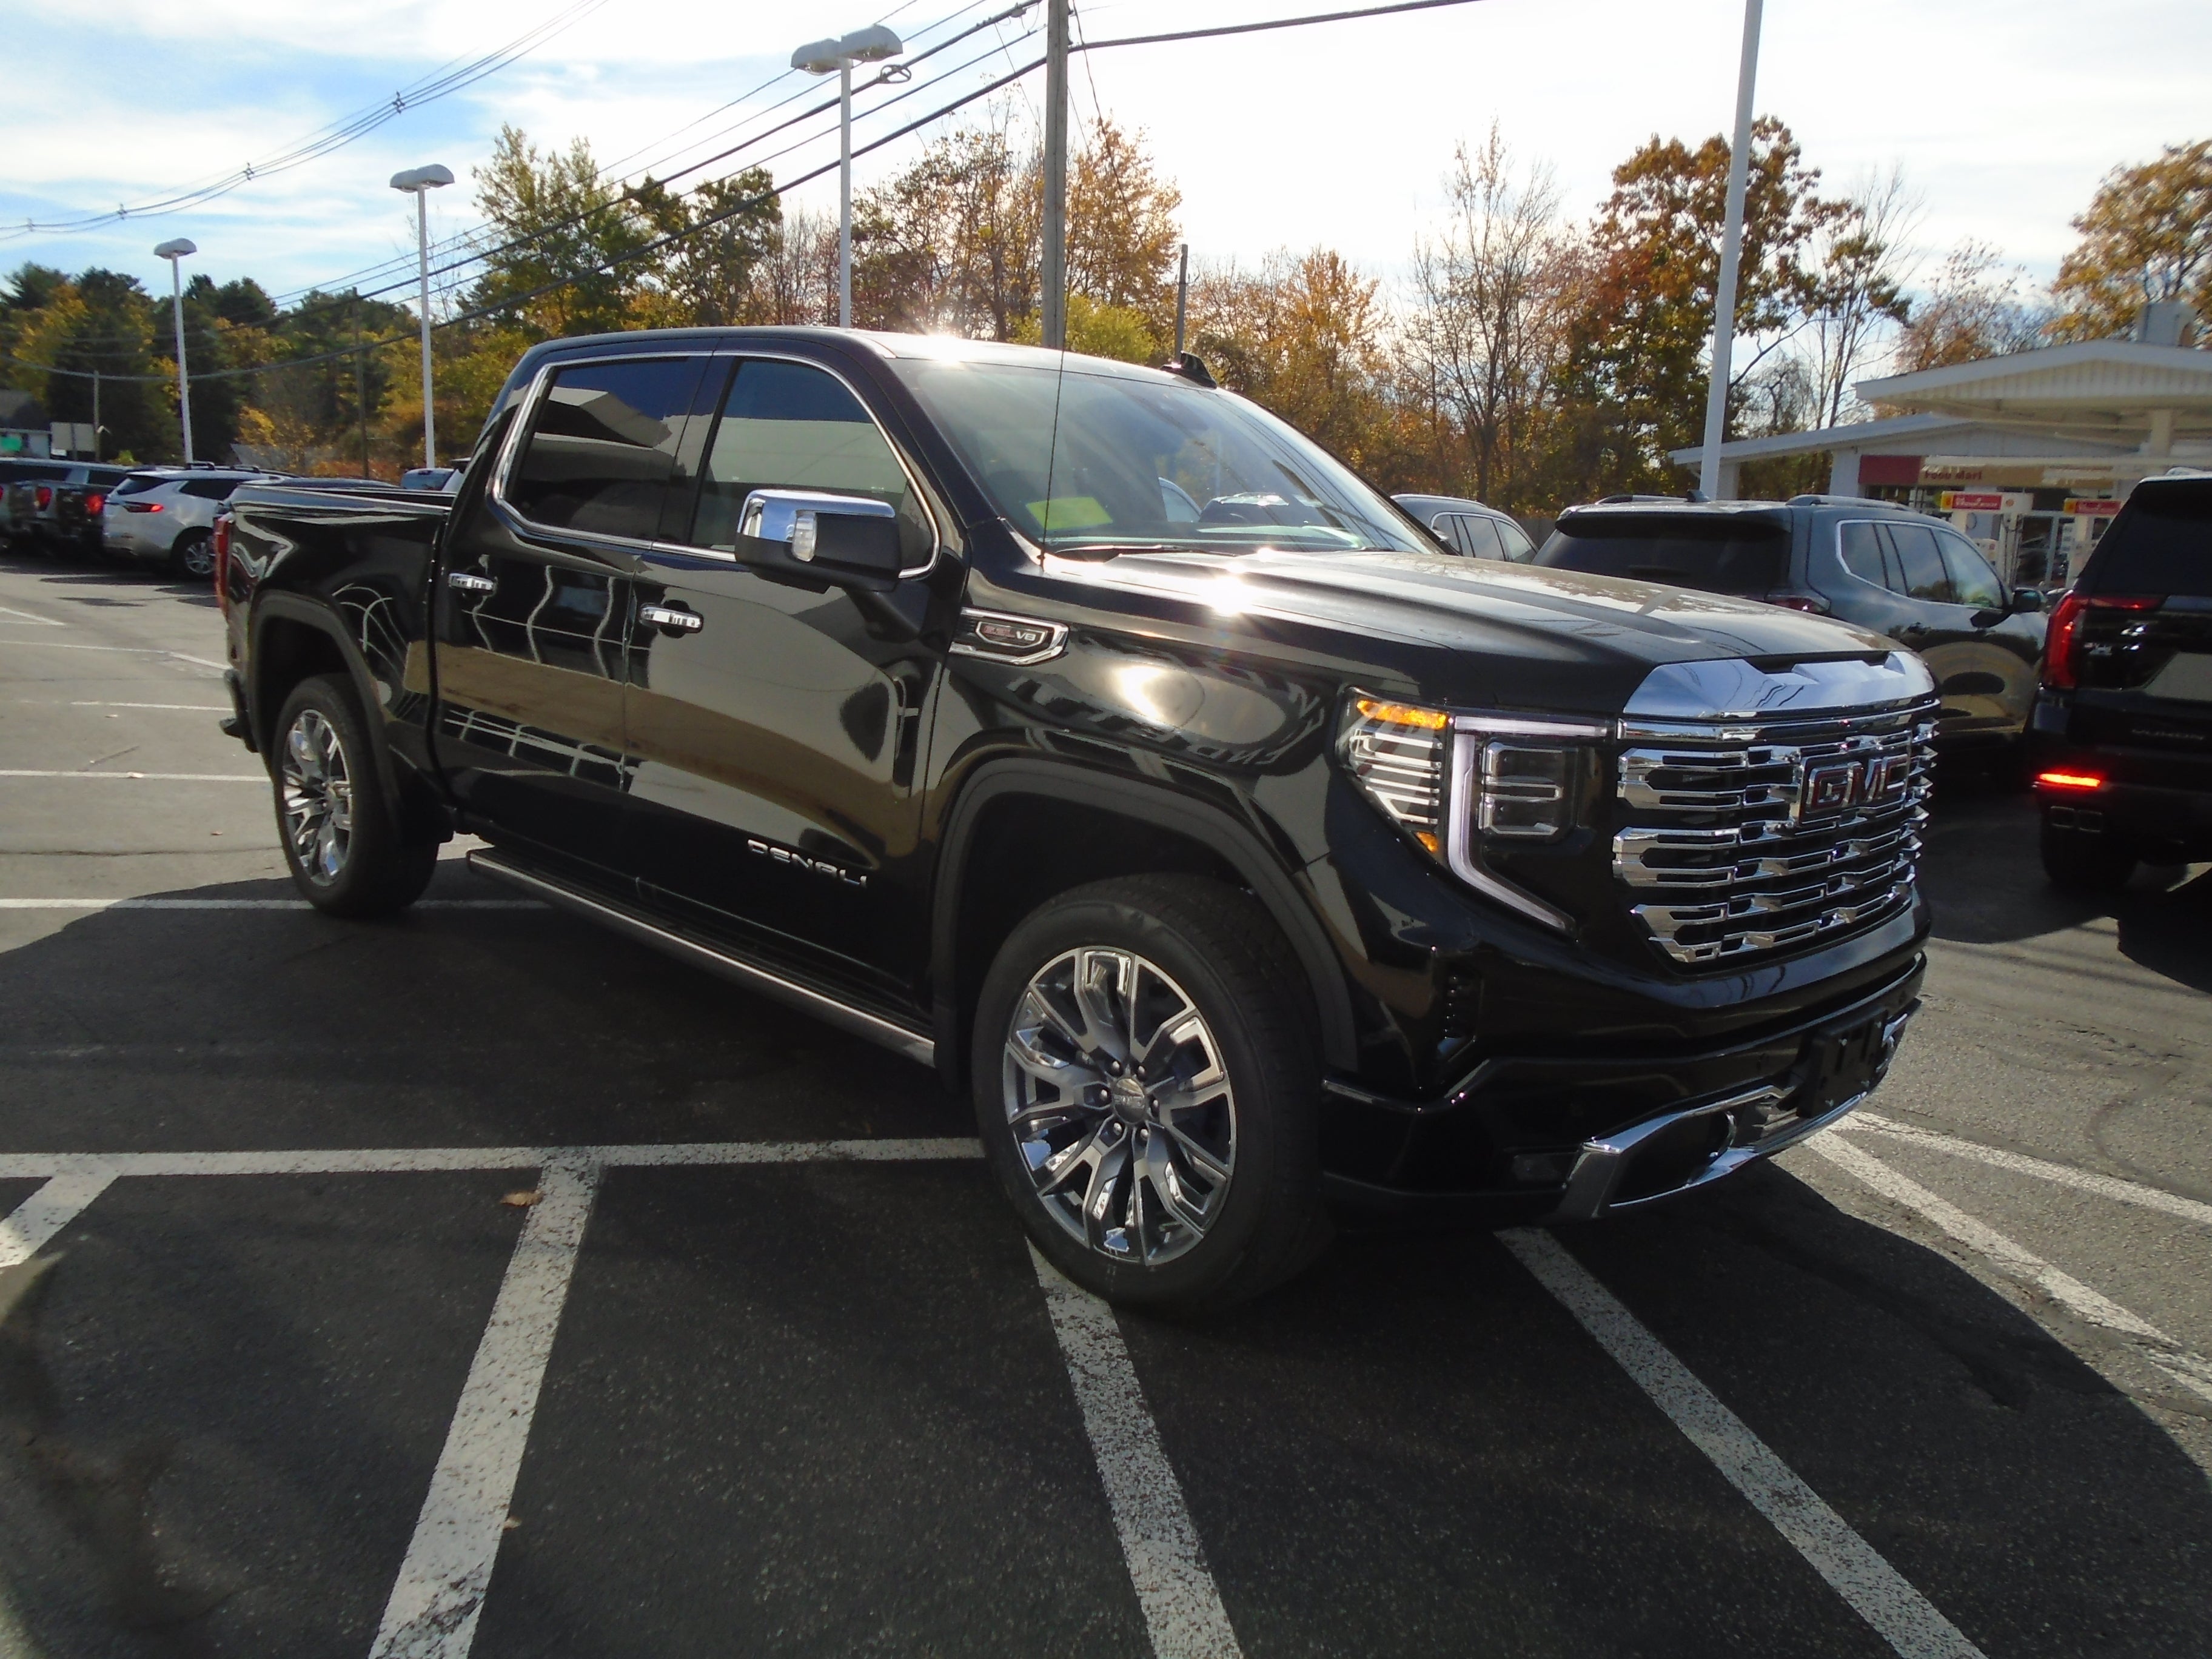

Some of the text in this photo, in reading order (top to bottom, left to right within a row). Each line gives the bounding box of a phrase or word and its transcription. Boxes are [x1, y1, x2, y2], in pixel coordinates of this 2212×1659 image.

[1016, 631, 1037, 642] V8
[1806, 754, 1908, 811] GMC
[747, 839, 868, 888] DENALI
